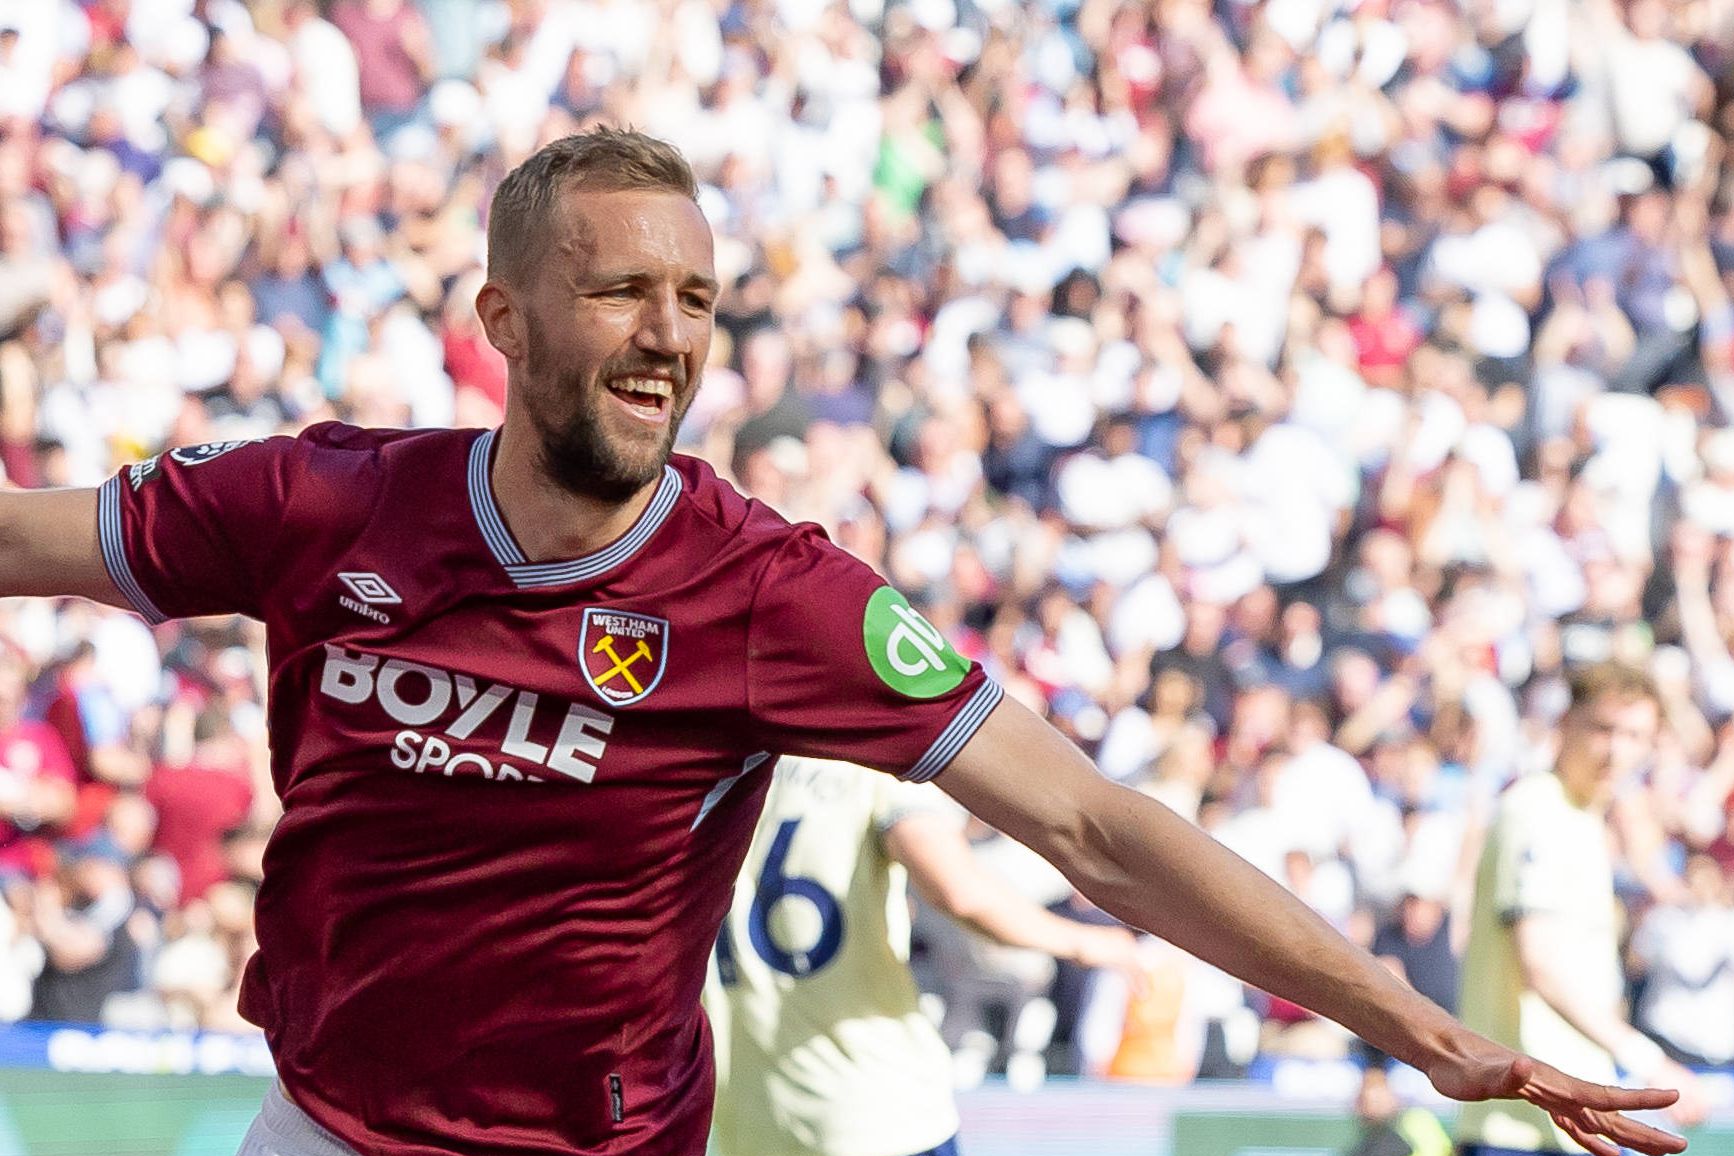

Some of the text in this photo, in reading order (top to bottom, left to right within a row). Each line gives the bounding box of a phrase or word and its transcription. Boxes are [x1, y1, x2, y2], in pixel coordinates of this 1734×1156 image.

[338, 596, 390, 625] umbro
[592, 614, 659, 635] WEST HAM
[605, 626, 645, 638] UNITED
[320, 642, 615, 784] BOYLE
